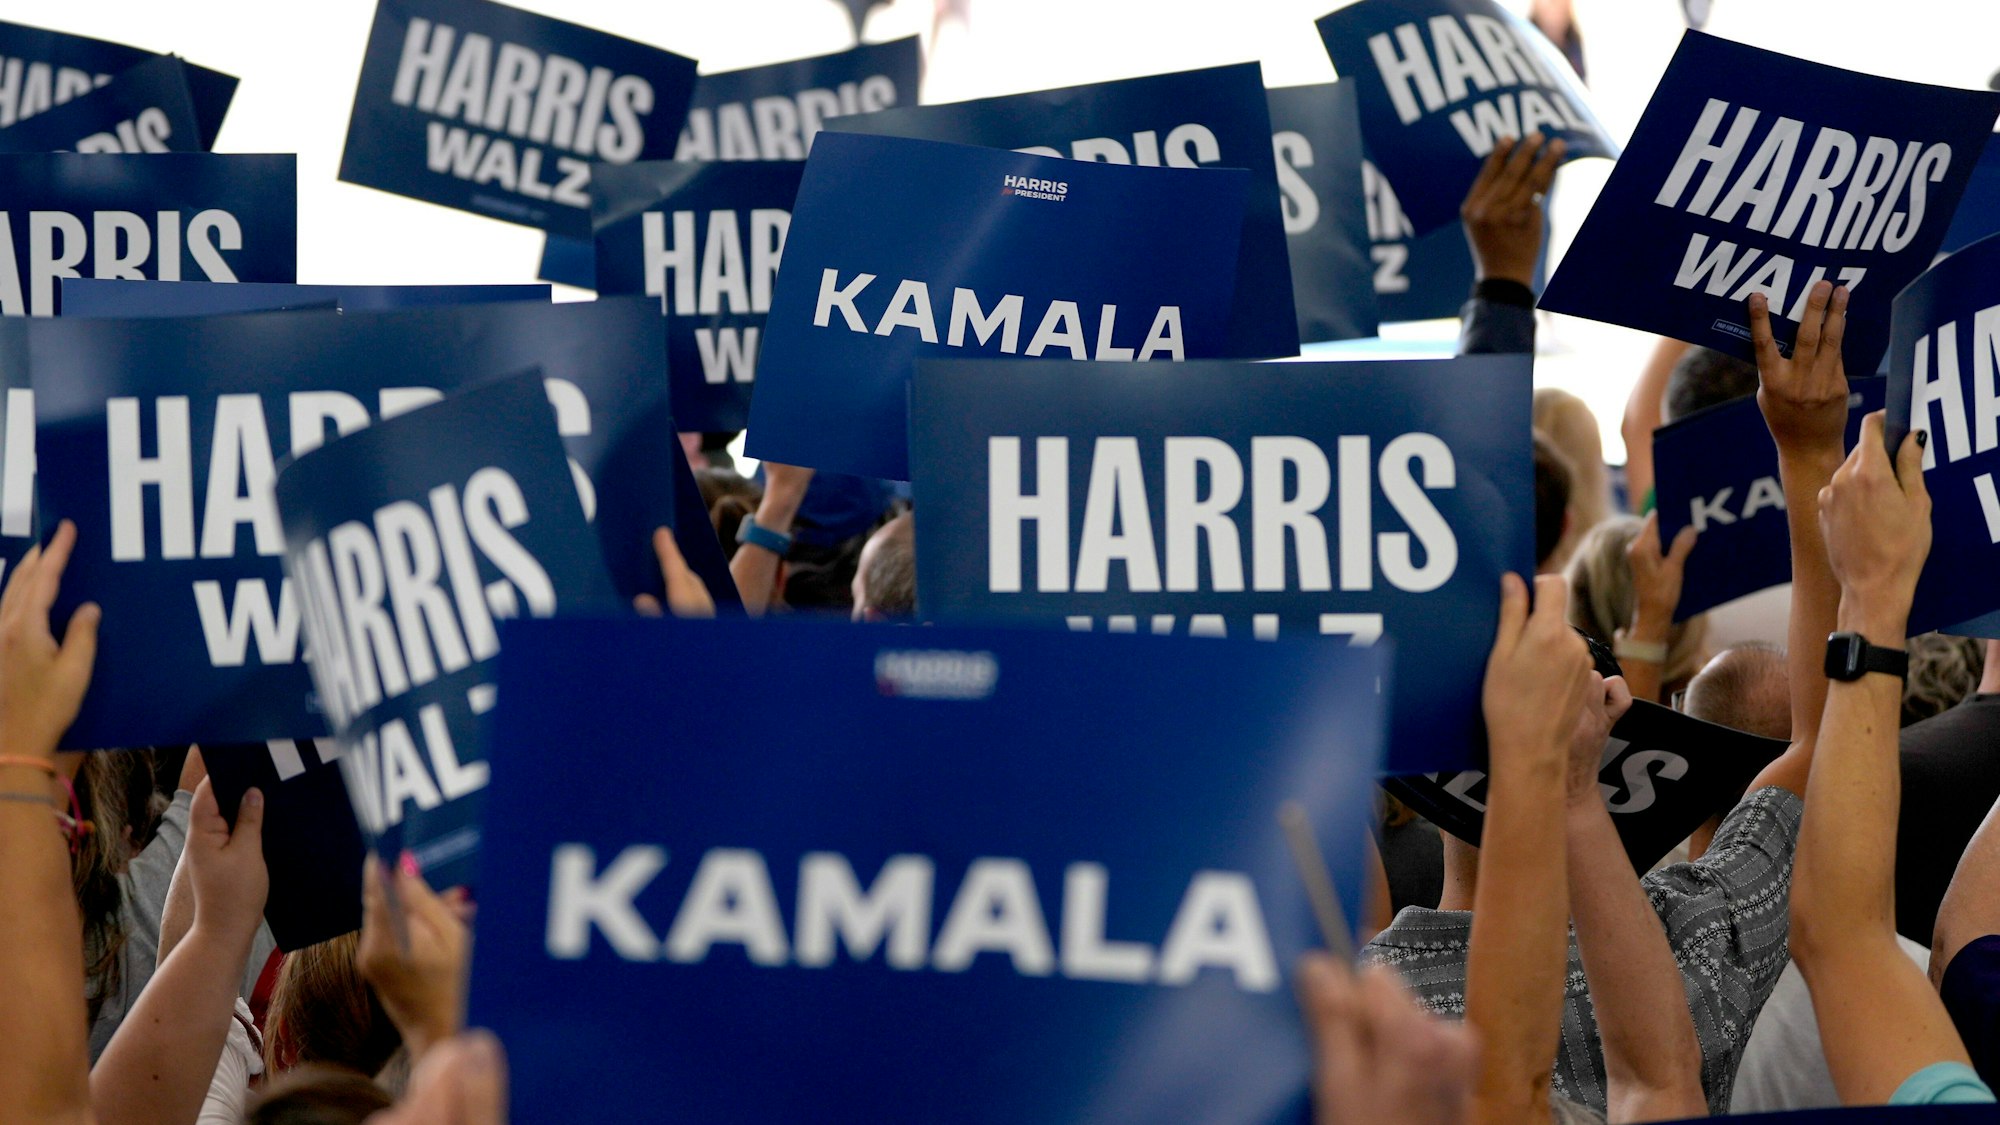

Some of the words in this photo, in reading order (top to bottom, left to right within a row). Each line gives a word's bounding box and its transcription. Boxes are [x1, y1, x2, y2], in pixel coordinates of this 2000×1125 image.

[0, 55, 113, 129] HAR
[392, 17, 655, 165] HARRIS
[427, 121, 592, 208] WALZ
[1004, 175, 1068, 194] HARRIS
[1014, 188, 1066, 202] PRESIDENT
[1654, 97, 1952, 253] HARRIS
[813, 267, 1187, 363] KAMALA
[988, 432, 1458, 594] HARRIS
[342, 681, 498, 836] WAL
[544, 840, 1280, 994] KAMALA
